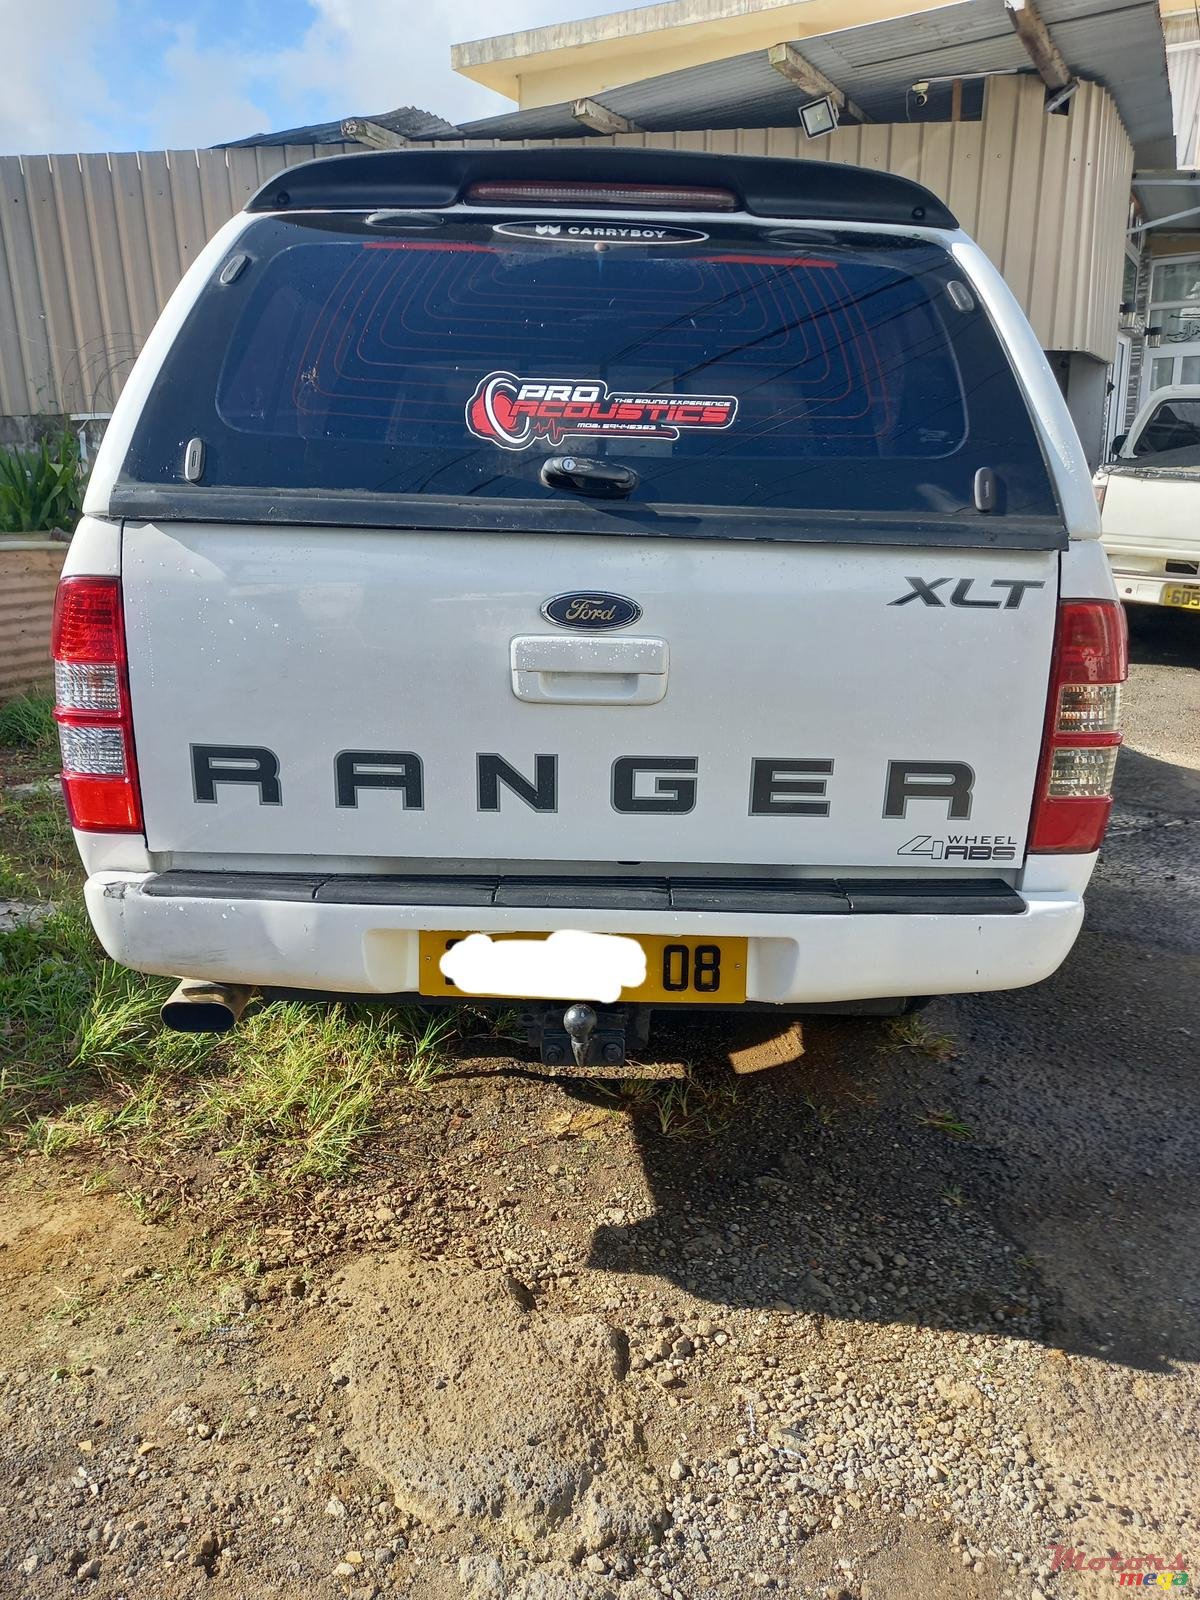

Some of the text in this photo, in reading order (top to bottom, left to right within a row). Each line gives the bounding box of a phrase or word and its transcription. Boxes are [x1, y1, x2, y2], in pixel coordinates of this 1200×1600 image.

[567, 226, 667, 239] CARRYBOY
[517, 385, 600, 401] PRO
[634, 397, 669, 406] SOUND
[669, 399, 732, 407] EXPERIENCE
[511, 402, 730, 422] ACOUSTICS
[886, 576, 1046, 610] XLT
[565, 598, 617, 621] Ford
[189, 742, 976, 820] RANGER
[896, 835, 1018, 860] 4 WHEEL
[944, 845, 1016, 860] ABS
[663, 944, 721, 992] 08
